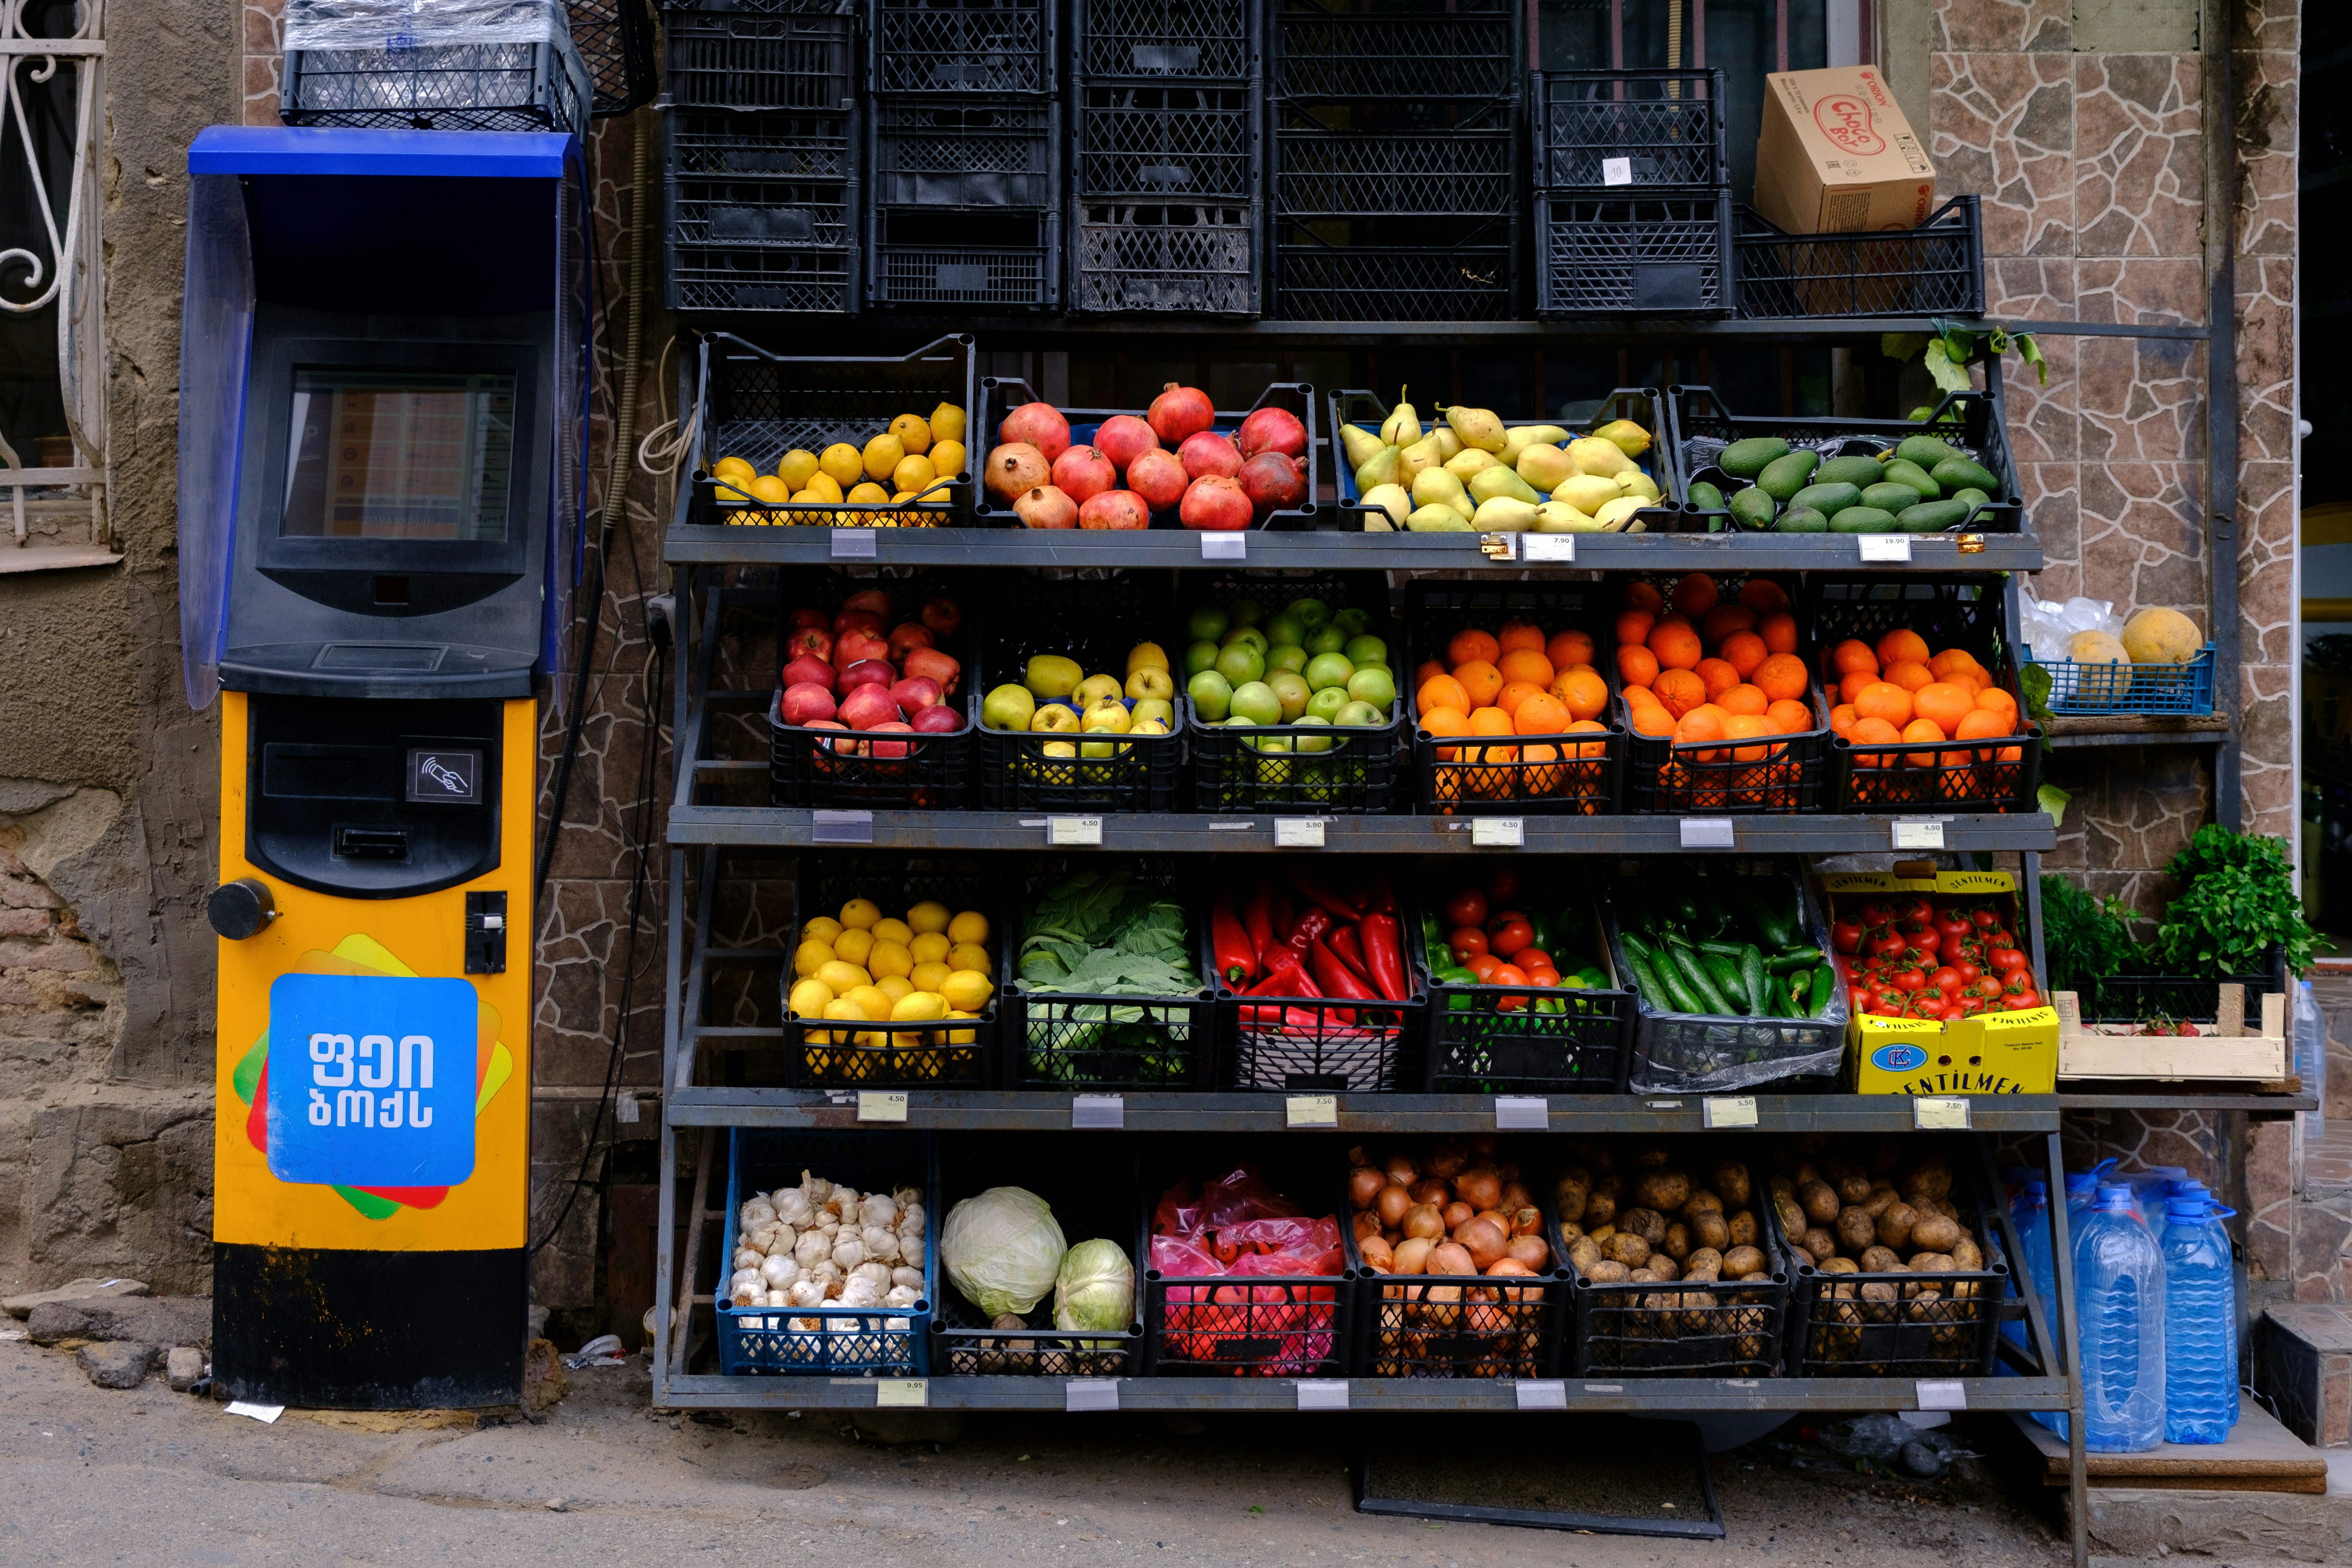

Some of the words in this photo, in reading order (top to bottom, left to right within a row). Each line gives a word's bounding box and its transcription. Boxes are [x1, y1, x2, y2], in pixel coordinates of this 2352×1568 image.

[1867, 81, 1888, 106] ORION
[1612, 167, 1621, 178] 10
[309, 1033, 434, 1088] ფეი
[309, 1088, 433, 1128] ბოქს
